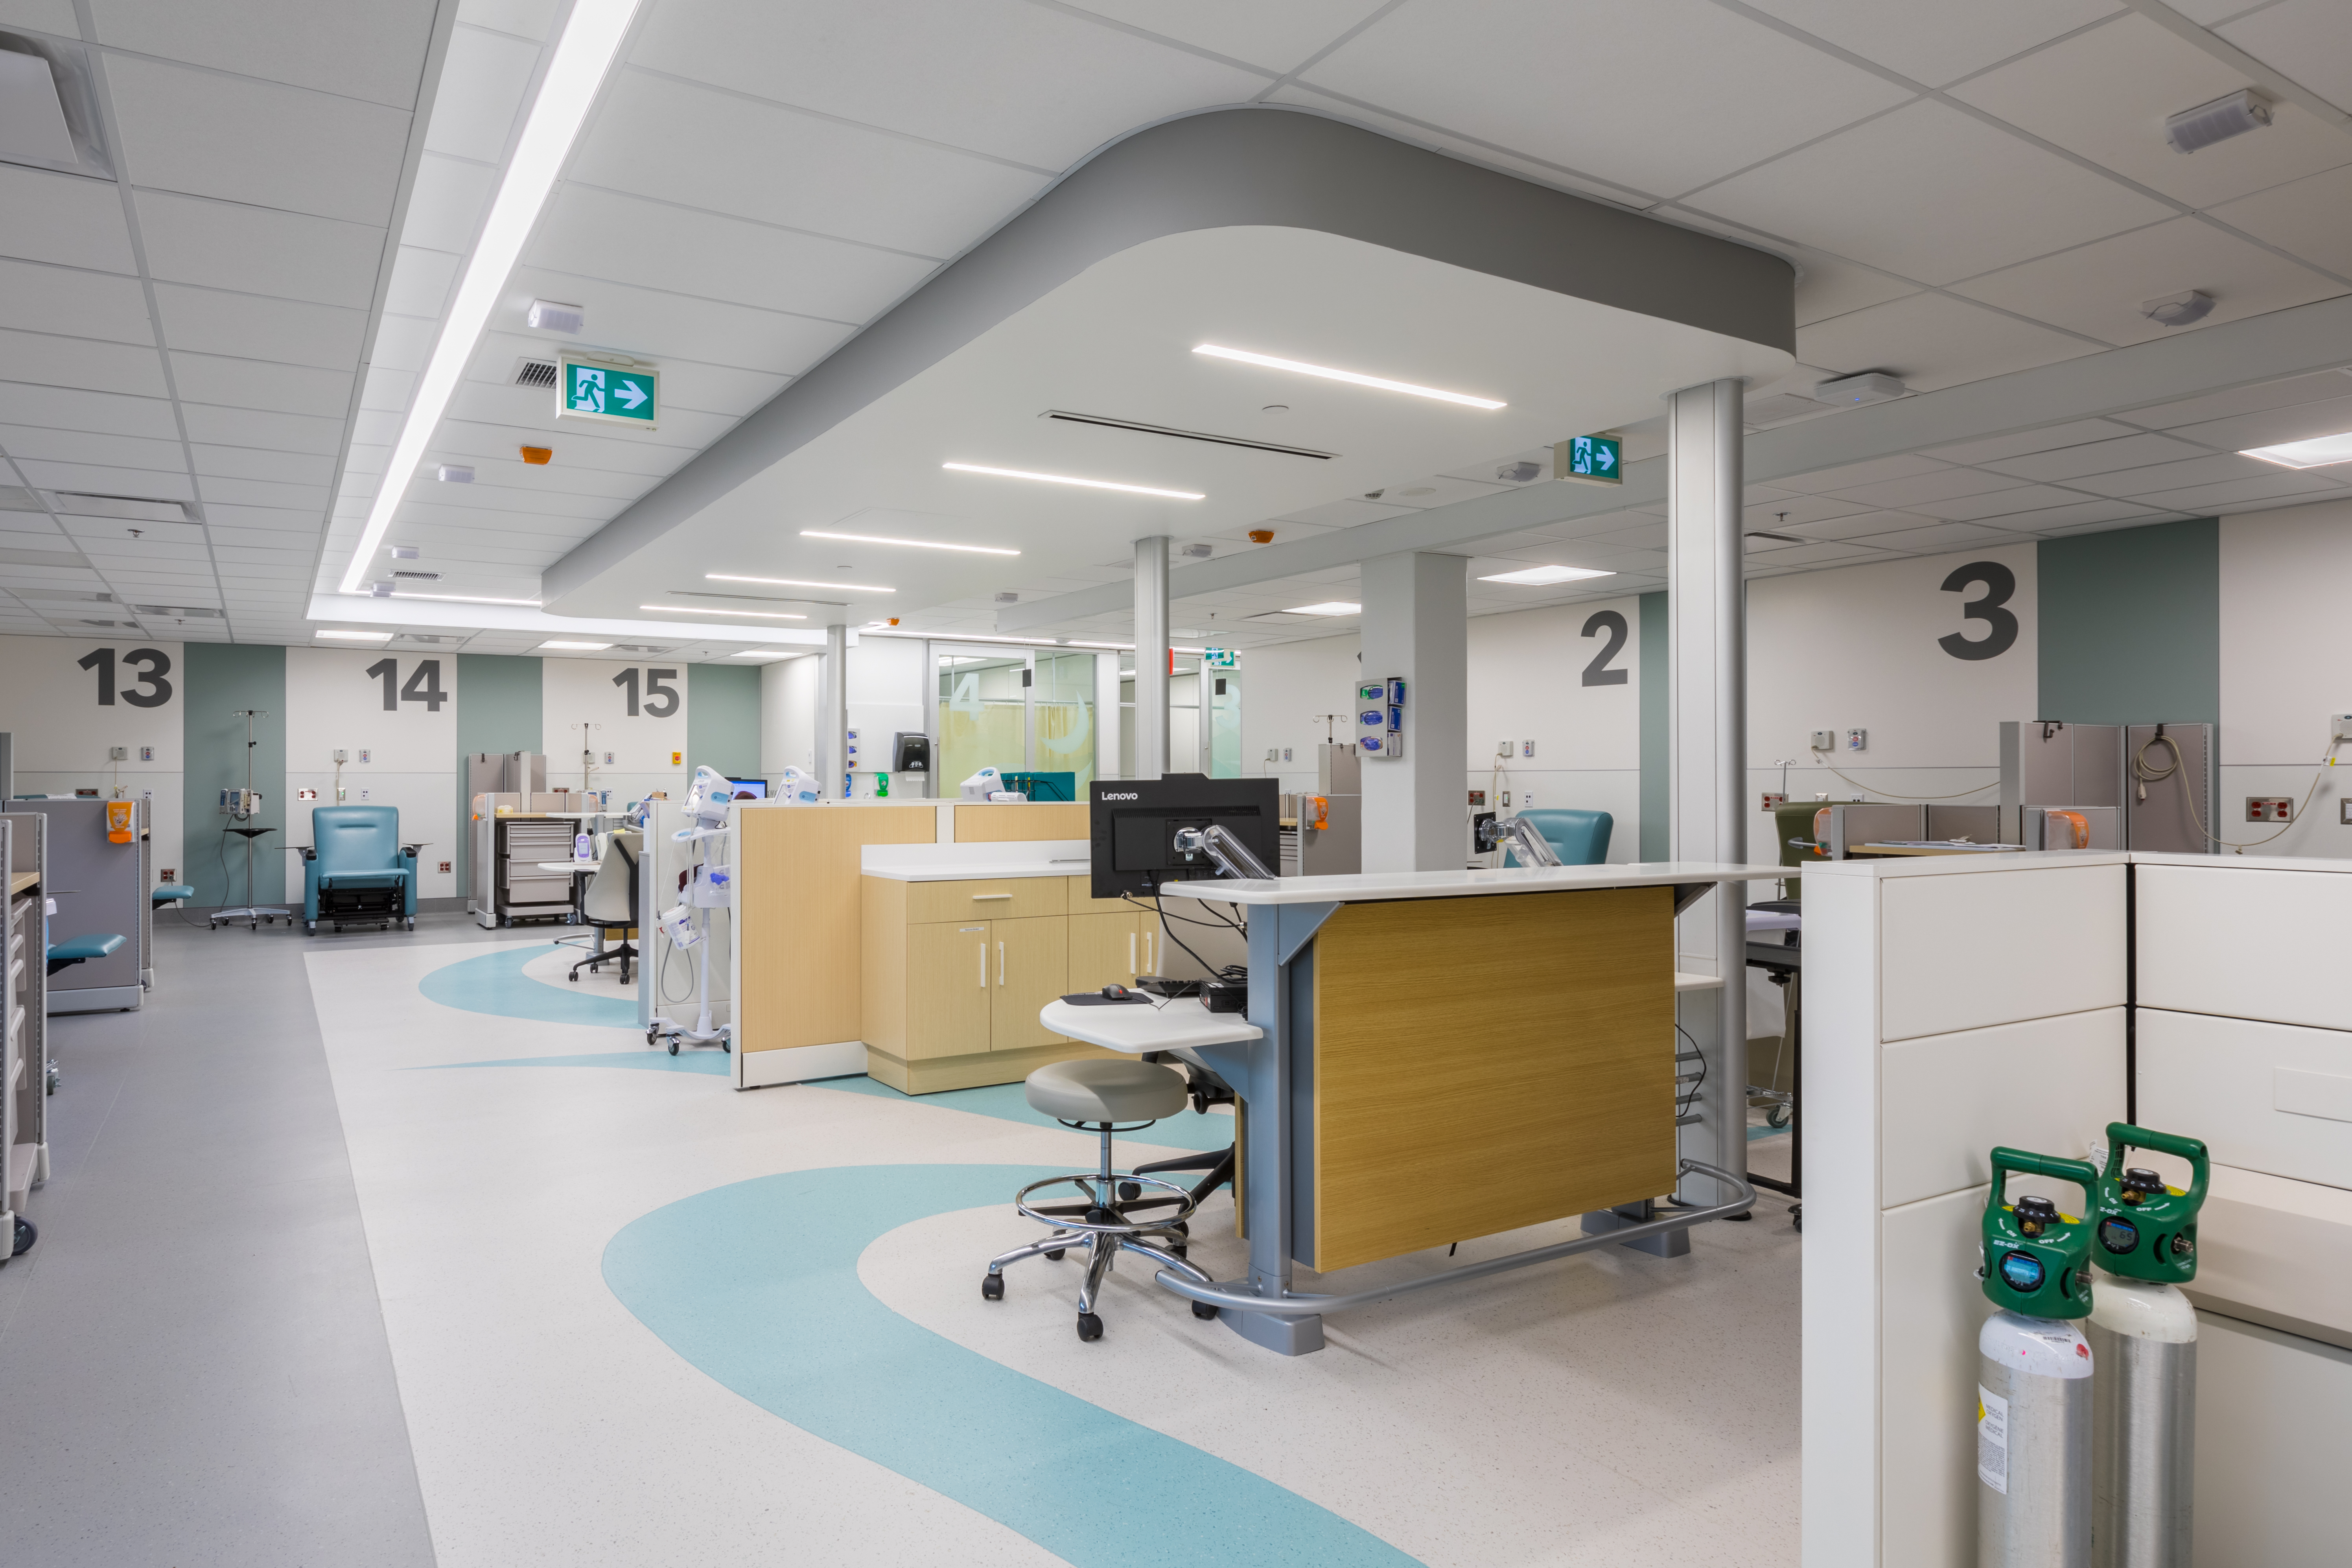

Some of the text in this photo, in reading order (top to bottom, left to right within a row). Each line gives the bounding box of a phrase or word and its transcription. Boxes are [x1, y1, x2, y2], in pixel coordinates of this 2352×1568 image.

[1938, 561, 2019, 661] 3
[1581, 610, 1628, 687] 2
[77, 648, 173, 708] 13
[365, 658, 448, 712] 14
[612, 667, 680, 718] 15
[949, 673, 985, 721] 4
[1215, 684, 1240, 730] 3
[1101, 792, 1138, 801] Lenovo
[2100, 1207, 2118, 1215] Z-OX
[1993, 1240, 2020, 1249] EZ-OX
[2119, 1231, 2133, 1241] 65
[1986, 1404, 2004, 1417] MEDICAL
[1986, 1409, 2003, 1421] OXYGEN
